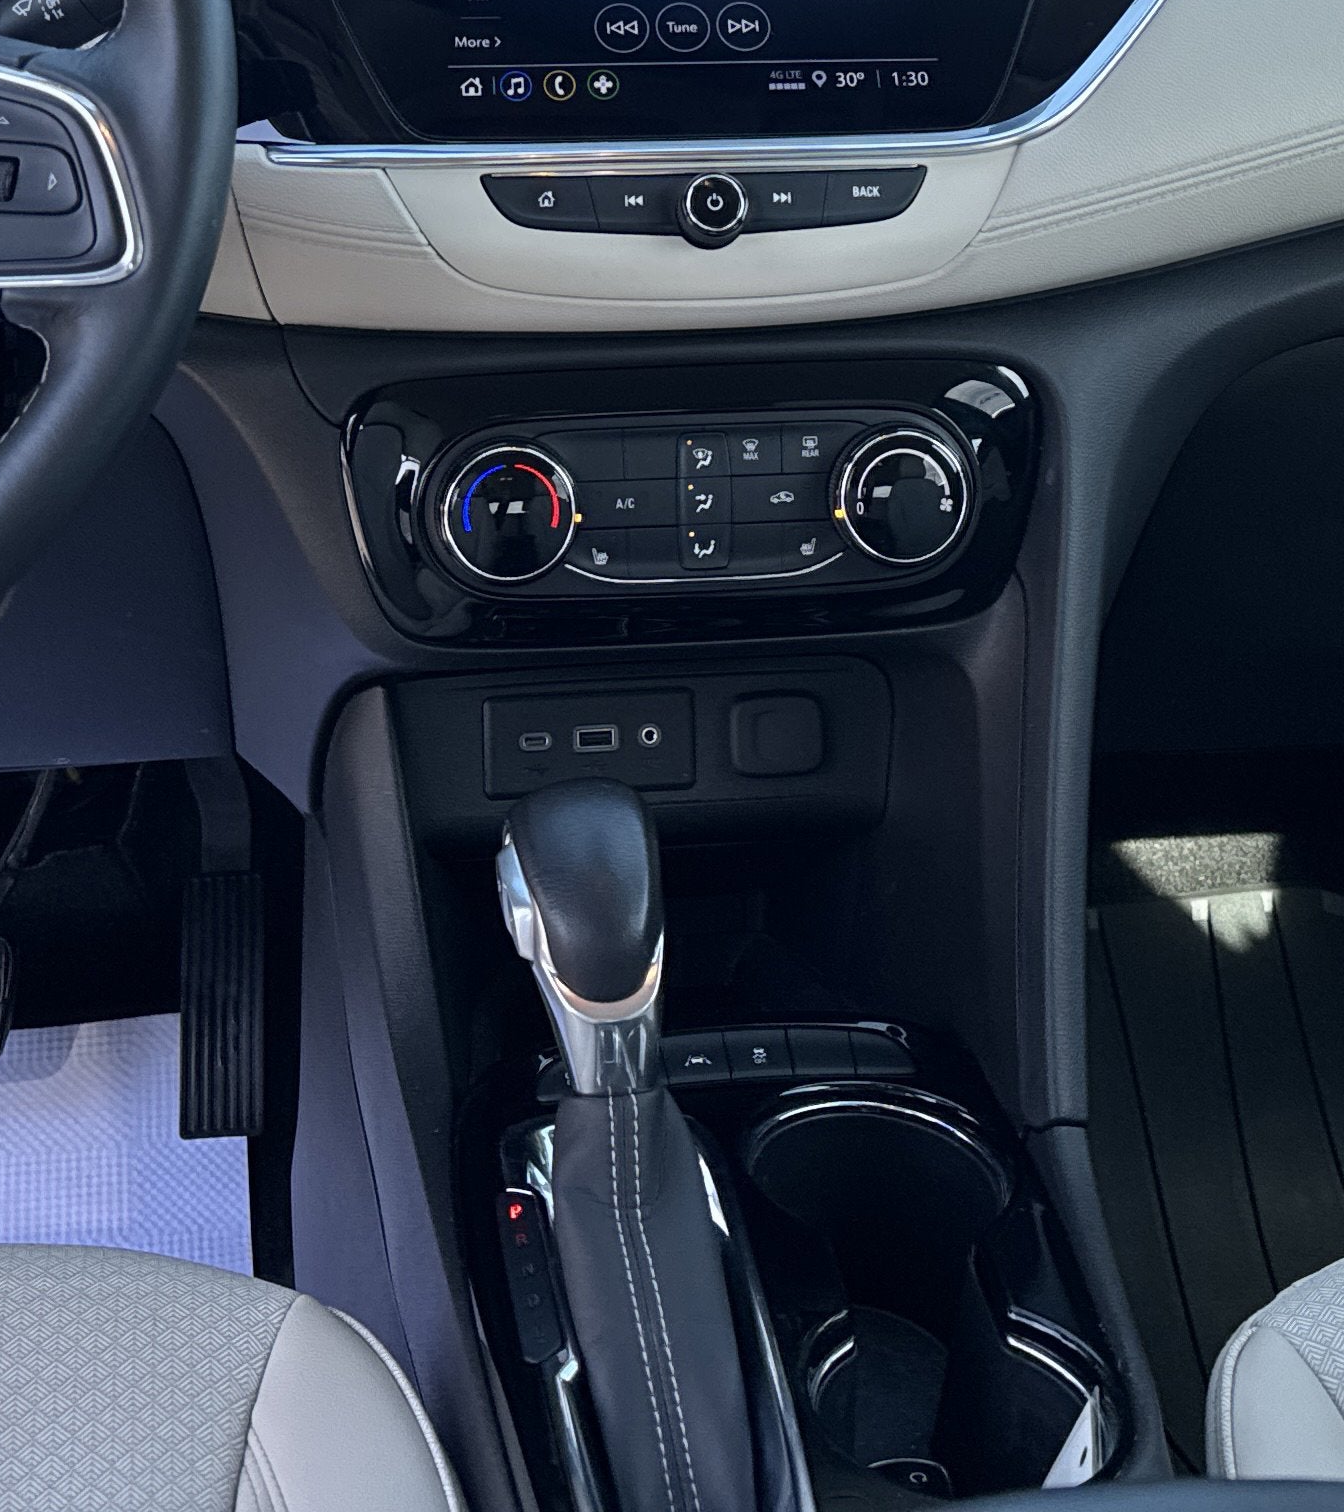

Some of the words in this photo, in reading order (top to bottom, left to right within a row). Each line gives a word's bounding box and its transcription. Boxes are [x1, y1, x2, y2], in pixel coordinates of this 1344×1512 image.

[666, 21, 698, 33] Tune
[454, 36, 490, 48] More
[769, 70, 784, 79] 4G
[785, 70, 803, 79] LTE
[891, 71, 929, 87] 1:30
[852, 185, 881, 198] BACK
[742, 452, 759, 461] MAX
[801, 449, 820, 458] REAR
[615, 497, 635, 510] A/C
[856, 501, 865, 515] 0
[508, 1203, 524, 1220] P
[516, 1233, 528, 1247] R
